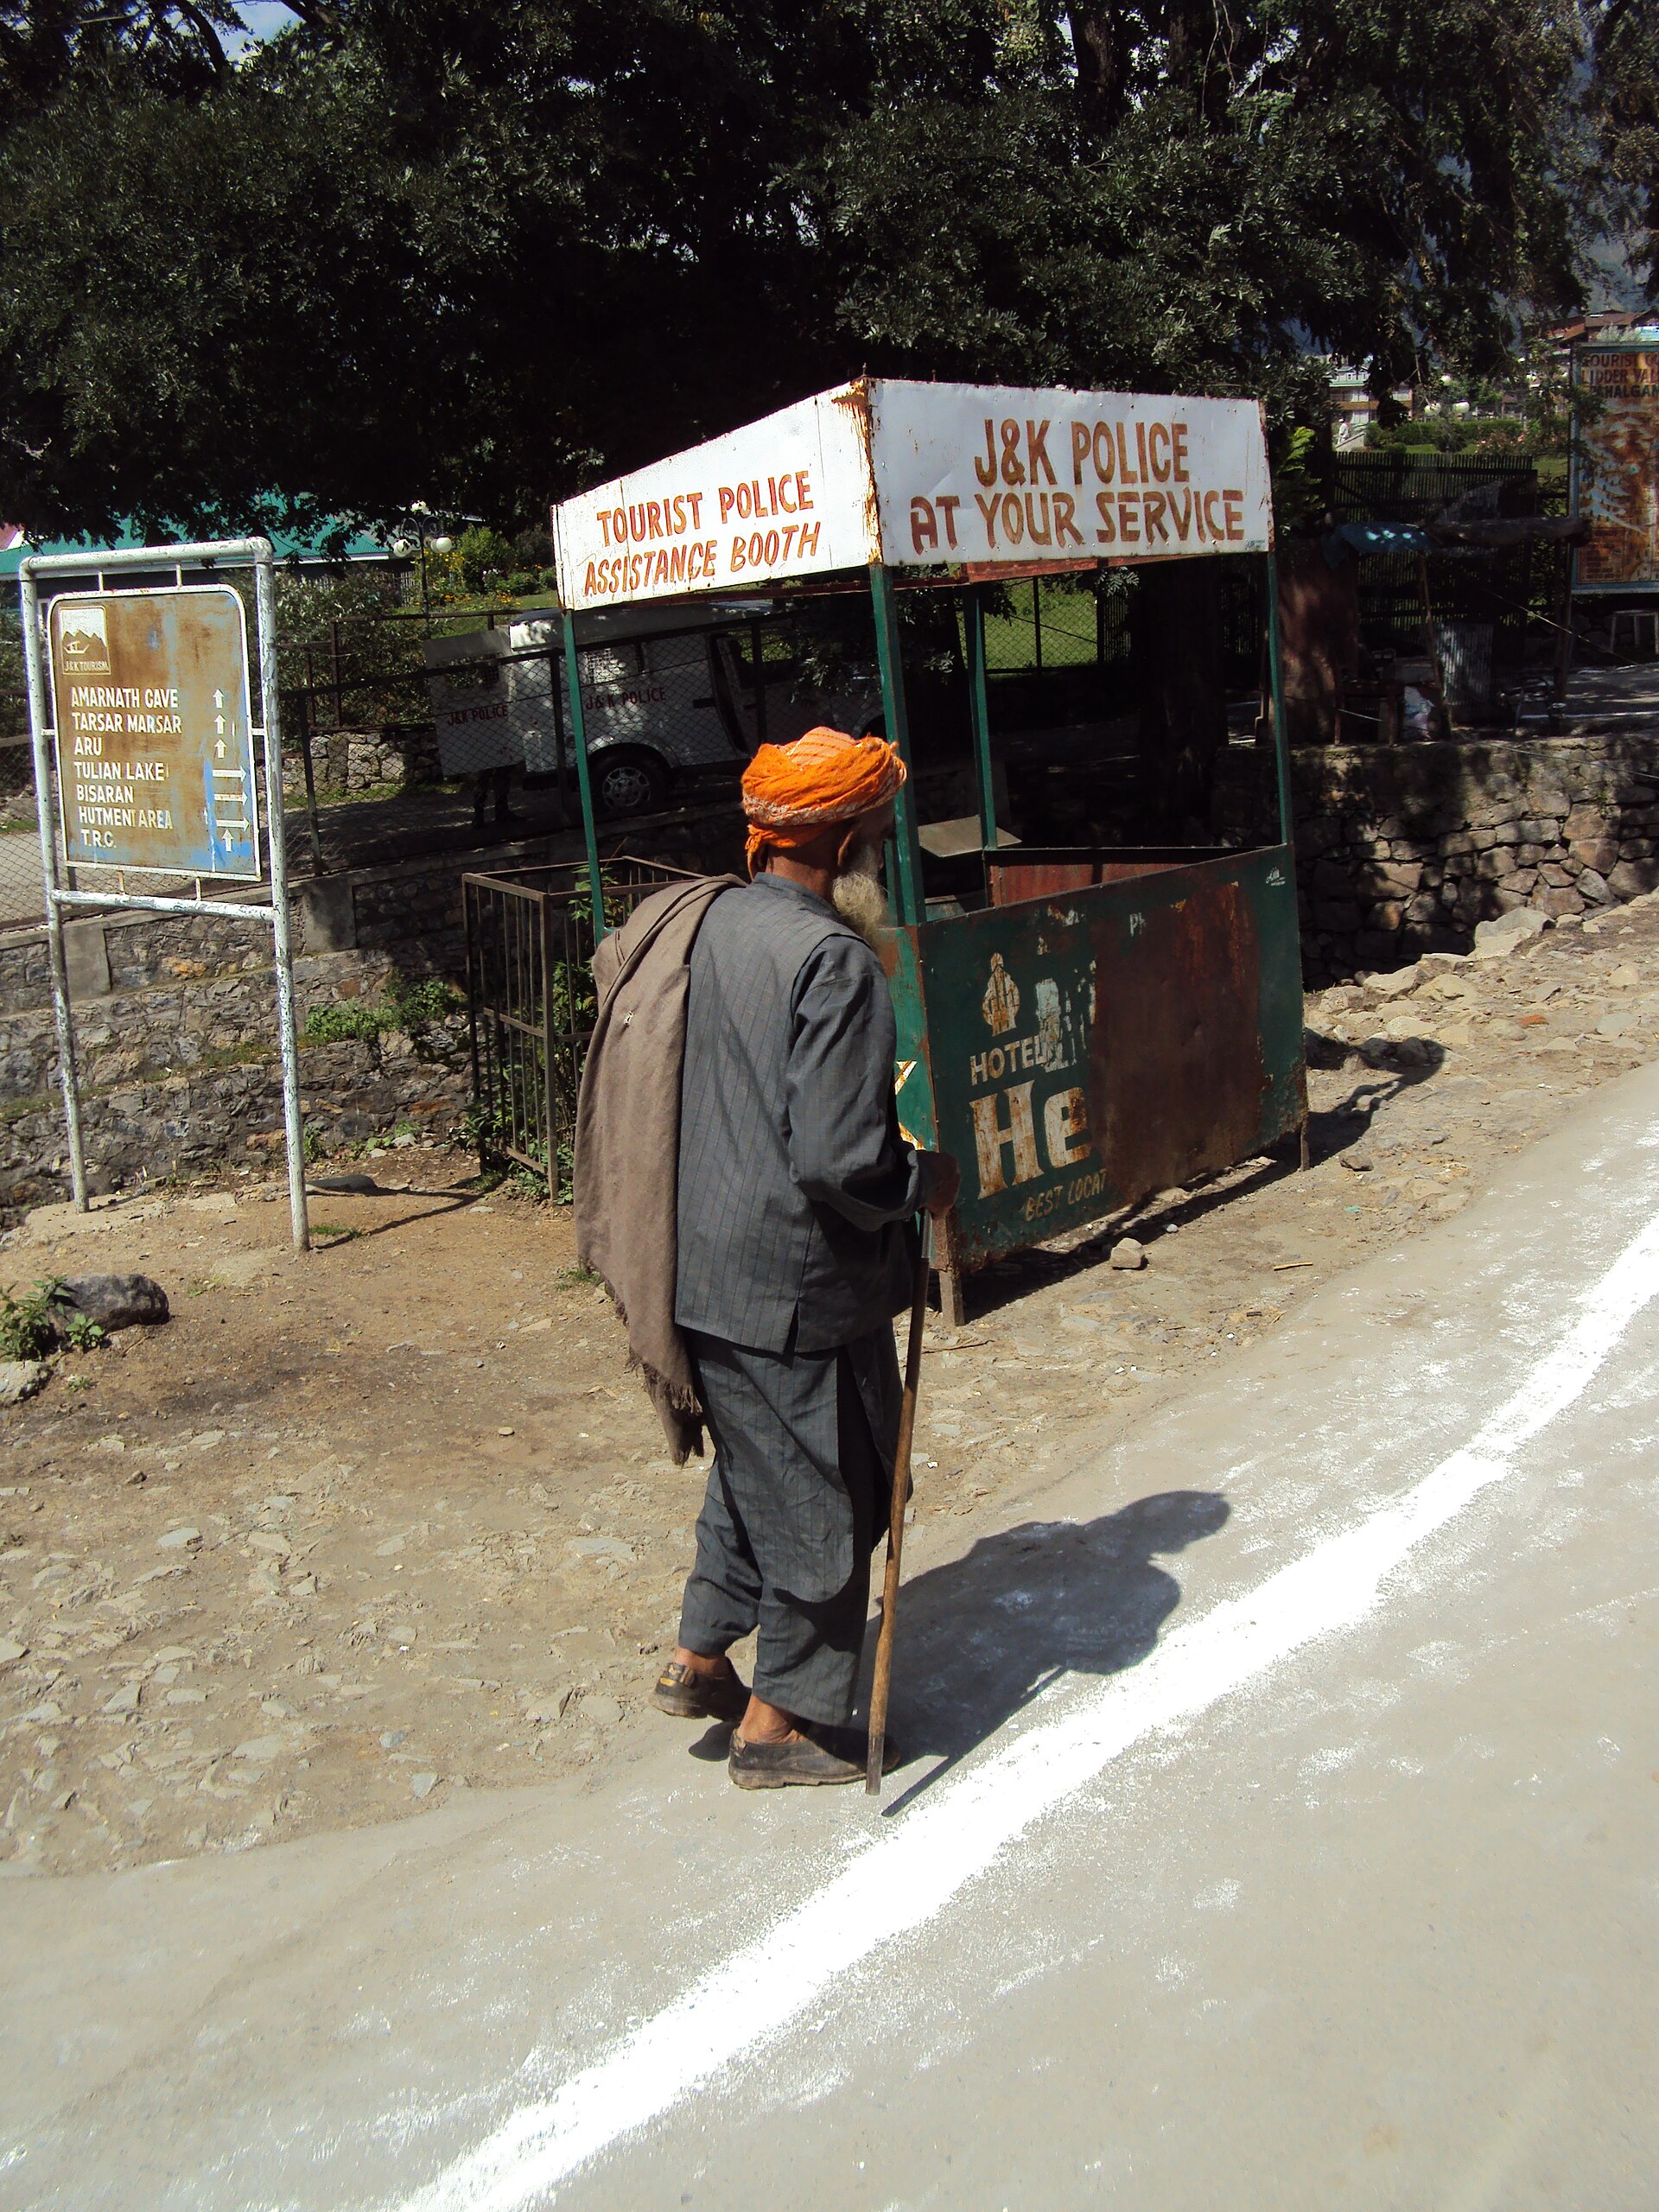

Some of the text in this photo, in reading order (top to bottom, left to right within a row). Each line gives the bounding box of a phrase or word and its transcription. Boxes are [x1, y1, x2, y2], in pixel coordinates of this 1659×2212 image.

[1582, 368, 1628, 384] LIDDER
[975, 418, 1190, 486] J&K POLICE
[597, 470, 814, 547] TOURIST POLICE
[910, 486, 1244, 555] AT YOUR SERVICE
[584, 521, 821, 597] ASSISTANCE BOOTH
[79, 659, 109, 671] TOURISM
[72, 686, 179, 709] AMARNATH CAVE
[622, 687, 667, 706] POLICE
[72, 711, 181, 734] TARSAR MARSAR
[472, 704, 509, 721] POLICE
[74, 736, 102, 756] ARU
[74, 761, 165, 781] TULIAN LAKE
[76, 784, 134, 804] BISARAN
[138, 809, 173, 830] AREA
[80, 829, 117, 848] T.R.C.
[969, 1034, 1048, 1086] HOTEL
[1025, 1185, 1064, 1222] BEST
